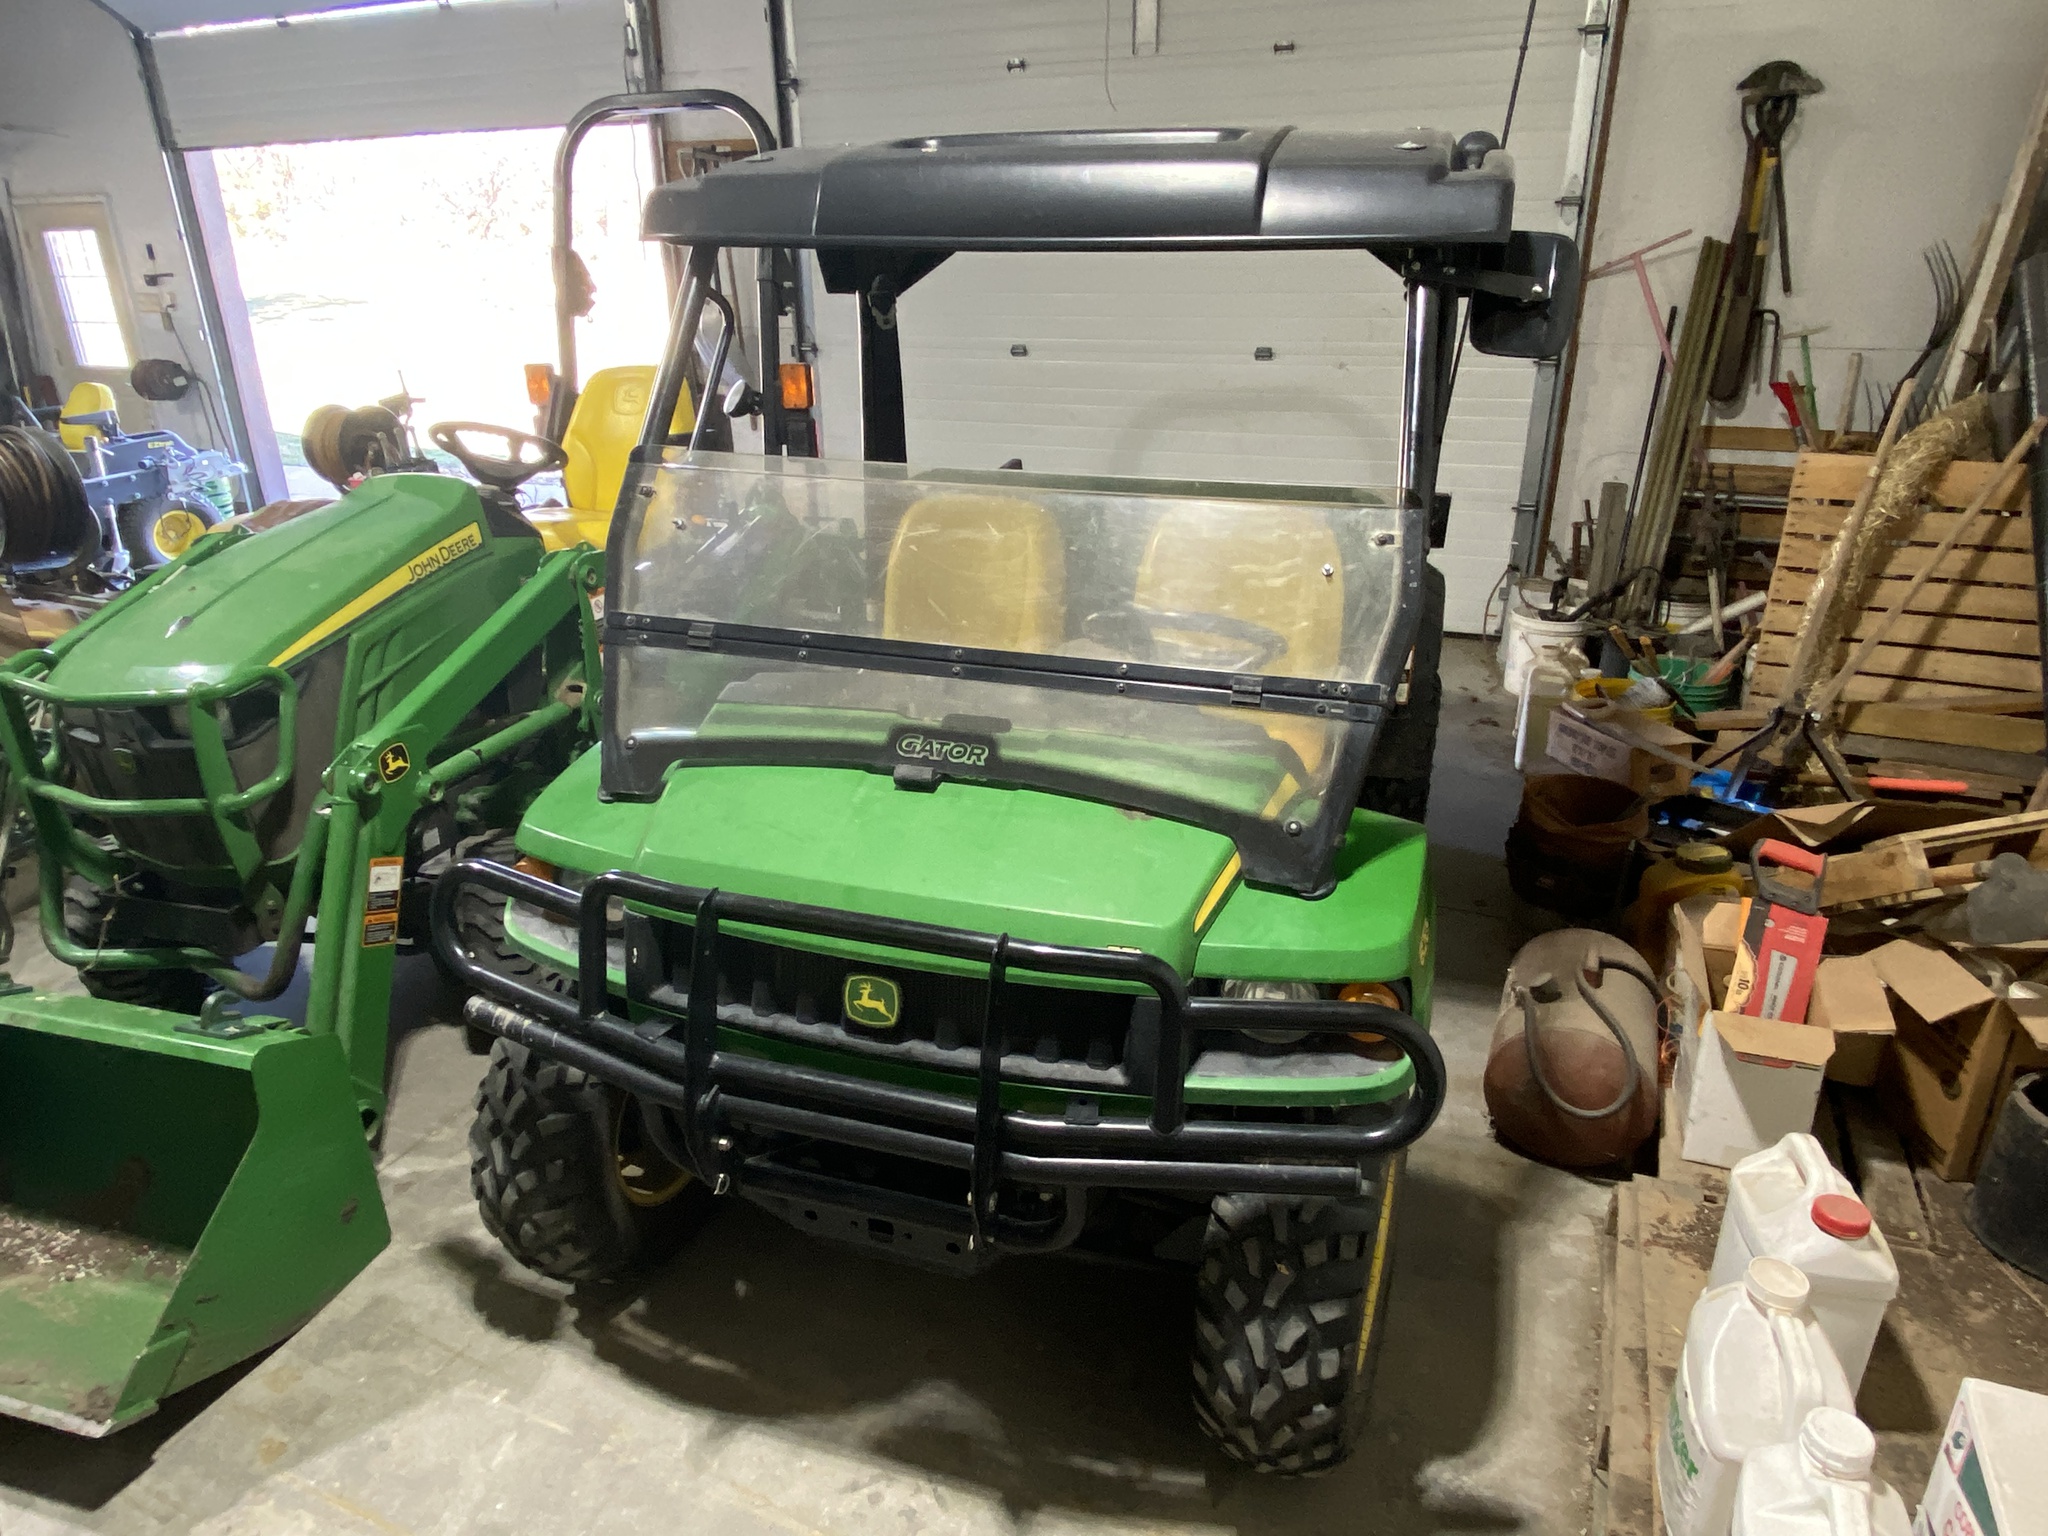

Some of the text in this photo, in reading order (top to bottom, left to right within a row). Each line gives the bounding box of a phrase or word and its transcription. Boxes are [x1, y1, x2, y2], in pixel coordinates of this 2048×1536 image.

[408, 533, 478, 582] JOHN DEERE
[896, 733, 989, 766] GATOR
[1737, 978, 1750, 991] 10
